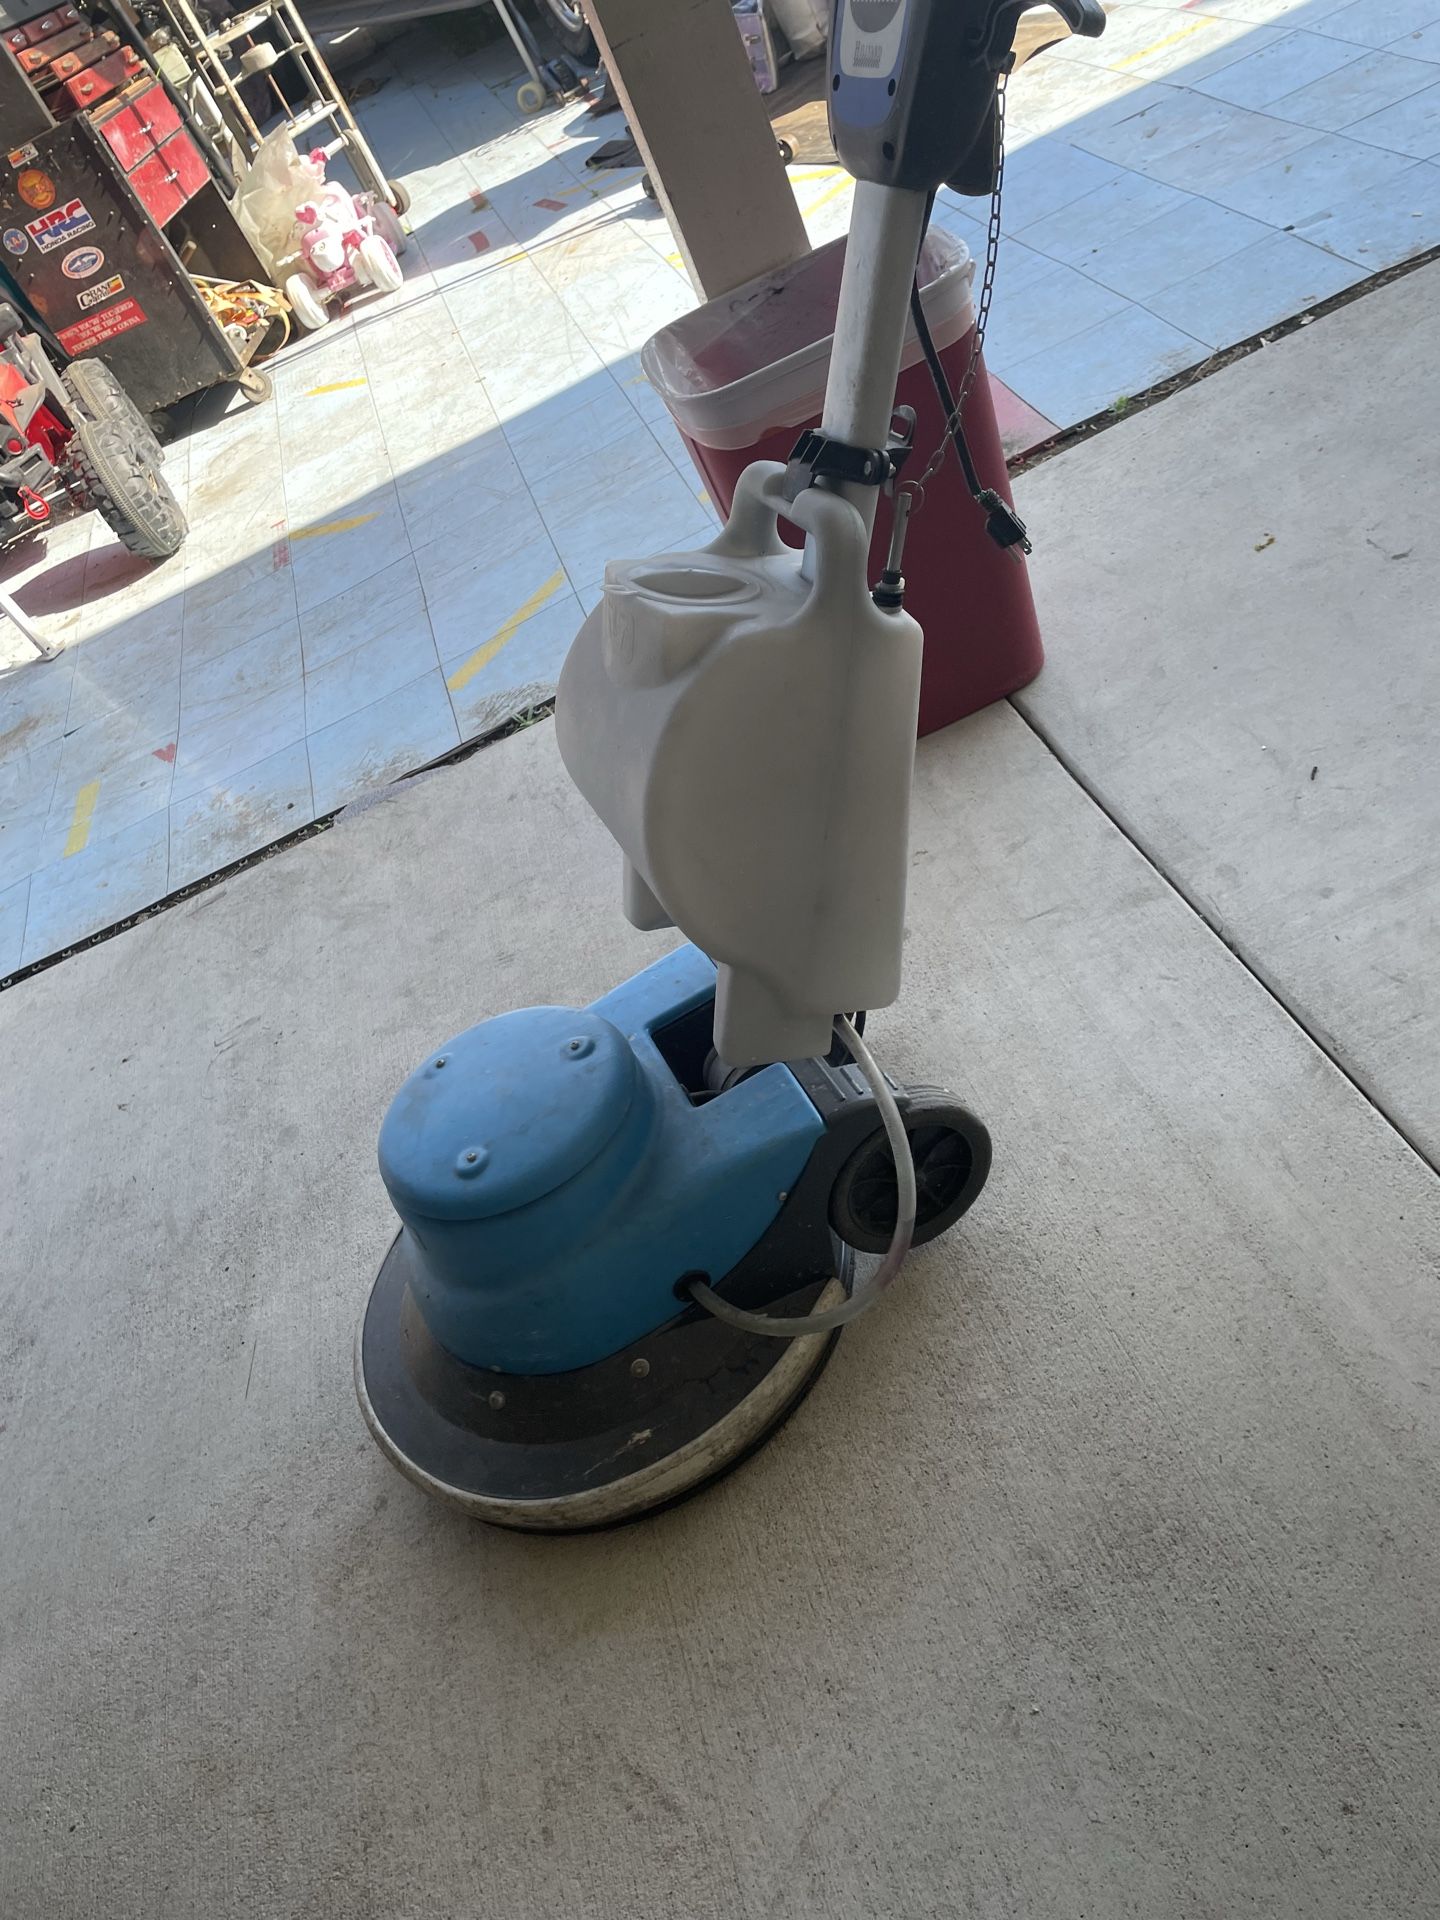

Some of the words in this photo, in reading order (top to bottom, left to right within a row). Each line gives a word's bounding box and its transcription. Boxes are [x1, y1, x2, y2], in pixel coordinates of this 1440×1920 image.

[28, 201, 90, 245] HRC
[41, 236, 67, 252] HONDA
[67, 222, 95, 238] RACING
